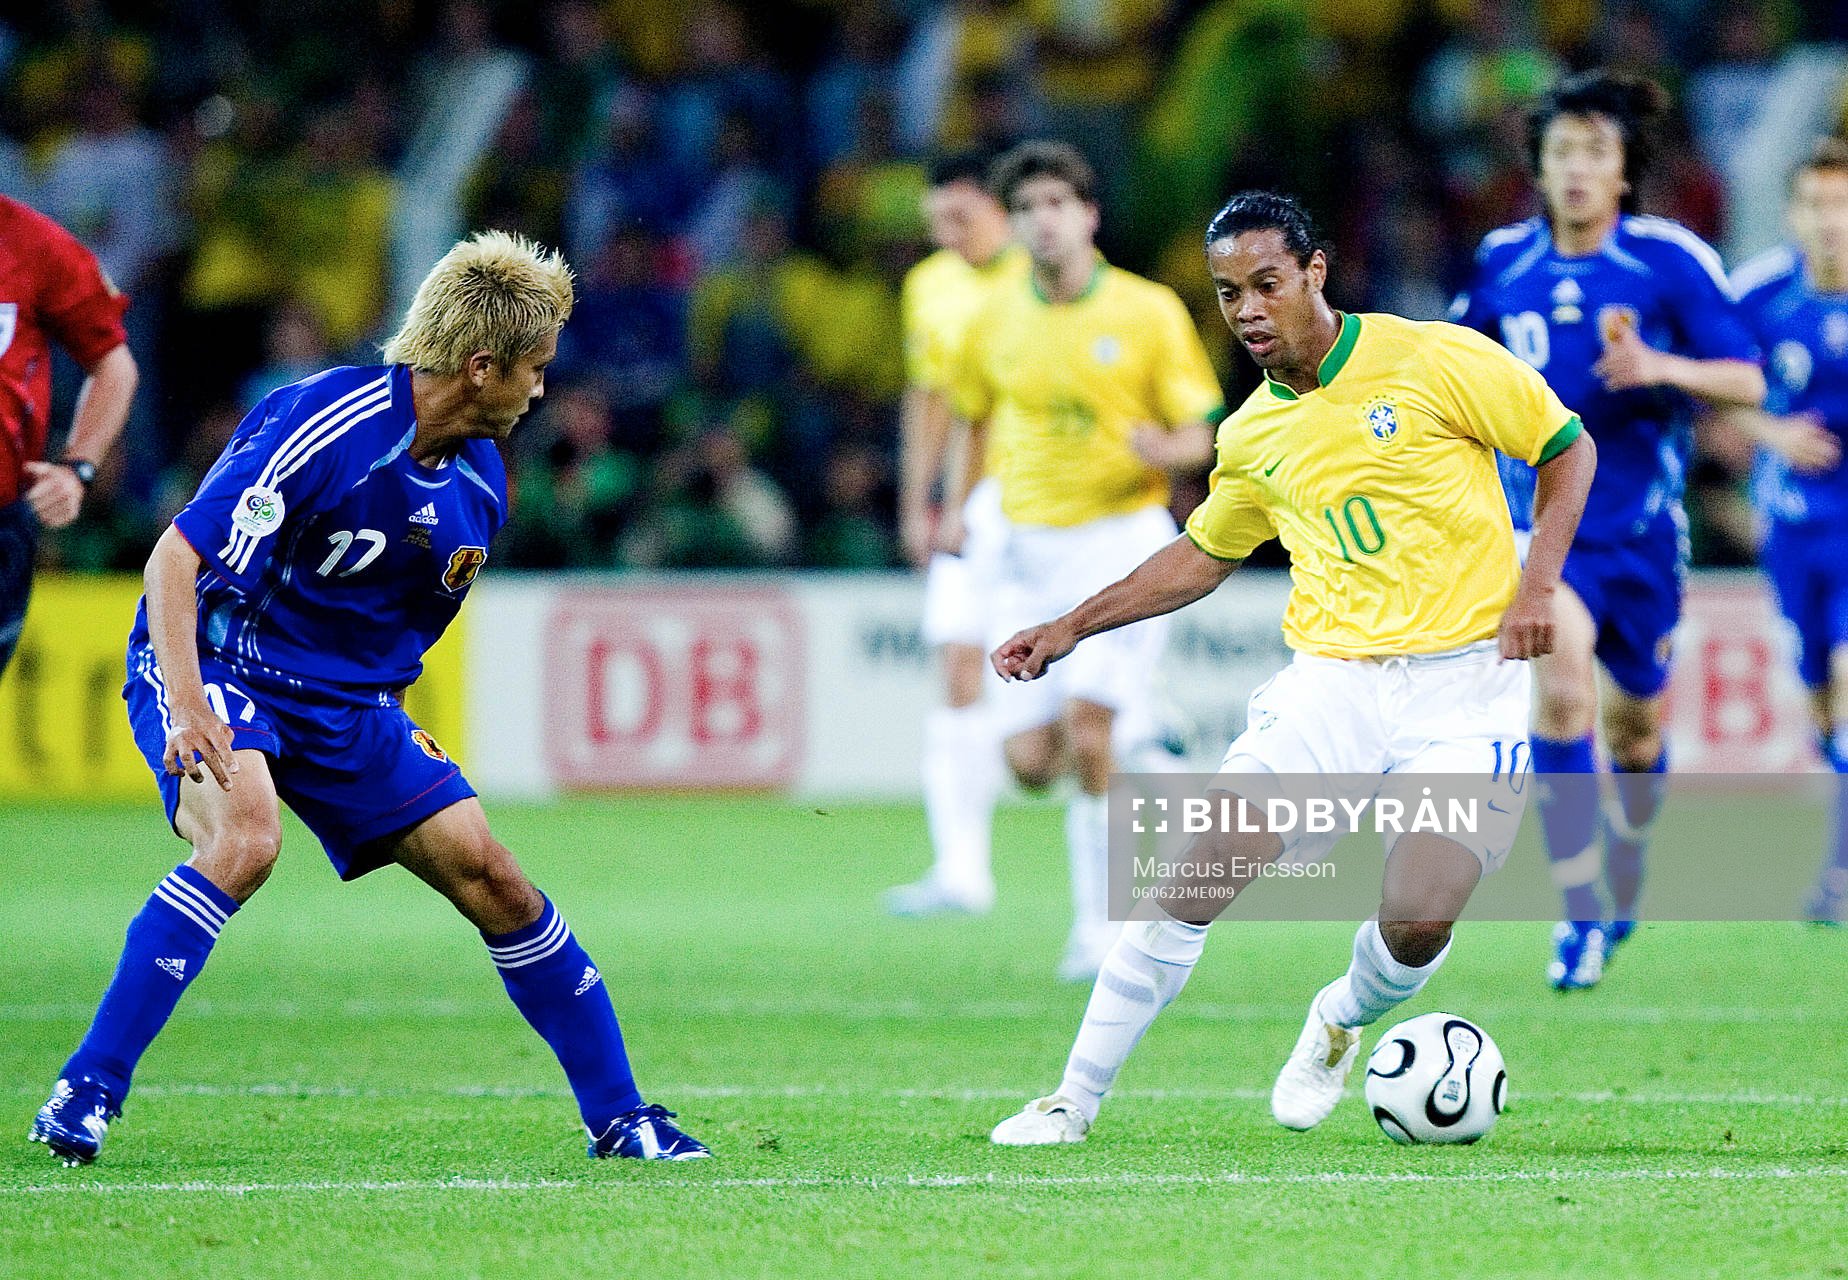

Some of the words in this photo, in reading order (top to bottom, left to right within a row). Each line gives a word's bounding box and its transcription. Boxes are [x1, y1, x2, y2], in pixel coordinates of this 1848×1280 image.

[1501, 310, 1550, 371] 10
[408, 514, 439, 526] adidas
[1324, 495, 1385, 562] 10
[316, 528, 387, 578] 17
[203, 683, 255, 724] 17
[588, 638, 763, 745] DB
[1491, 741, 1531, 795] 10
[155, 957, 185, 981] adidas
